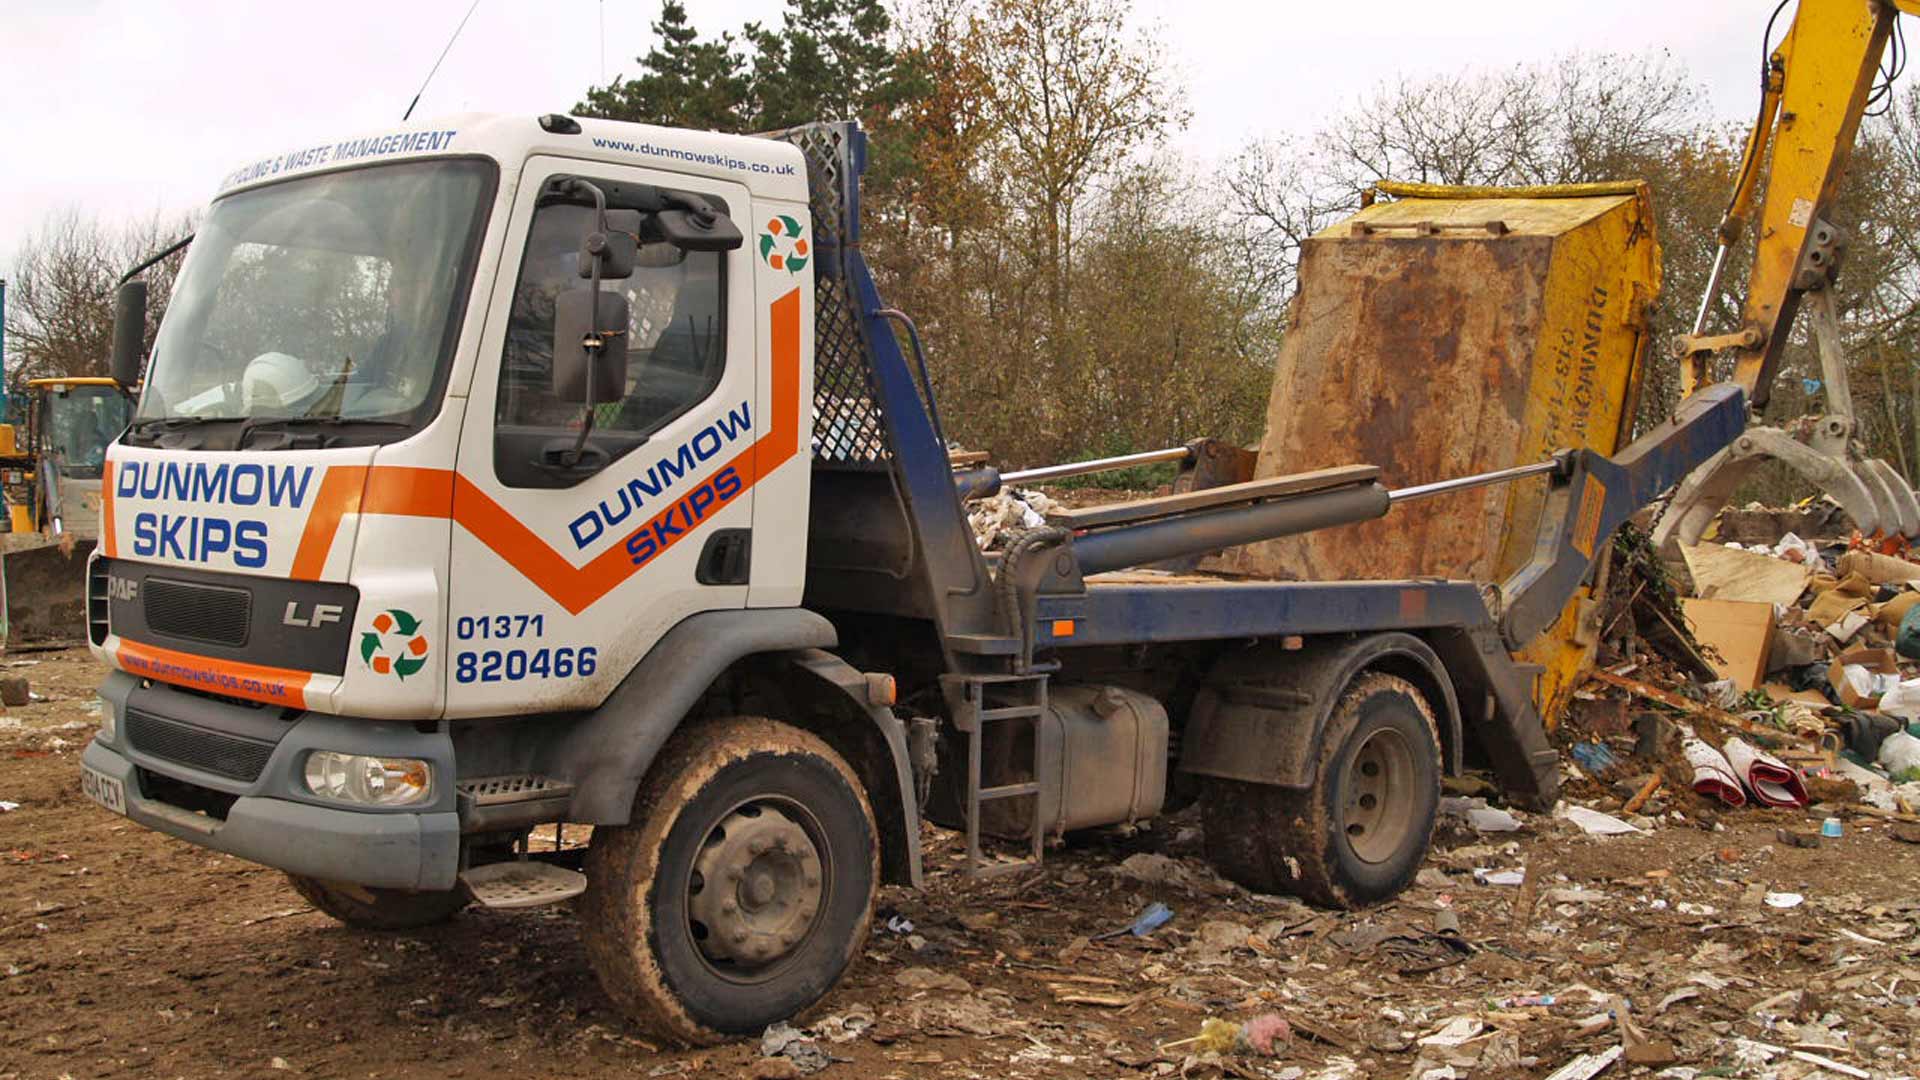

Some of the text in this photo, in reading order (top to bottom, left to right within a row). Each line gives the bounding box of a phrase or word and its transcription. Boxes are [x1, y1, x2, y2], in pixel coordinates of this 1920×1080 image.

[283, 145, 333, 171] WASTE
[332, 130, 456, 160] MANAGEMENT
[592, 136, 795, 176] www.dunmowskips.co.uk
[117, 461, 314, 509] DUNMOW
[568, 400, 752, 550] DUNMOW
[626, 466, 743, 565] SKIPS
[133, 512, 268, 569] SKIPS
[283, 601, 344, 628] LF
[457, 614, 545, 640] 01371
[124, 654, 287, 697] www.dunmowskips.co.uk
[455, 646, 598, 684] 820466
